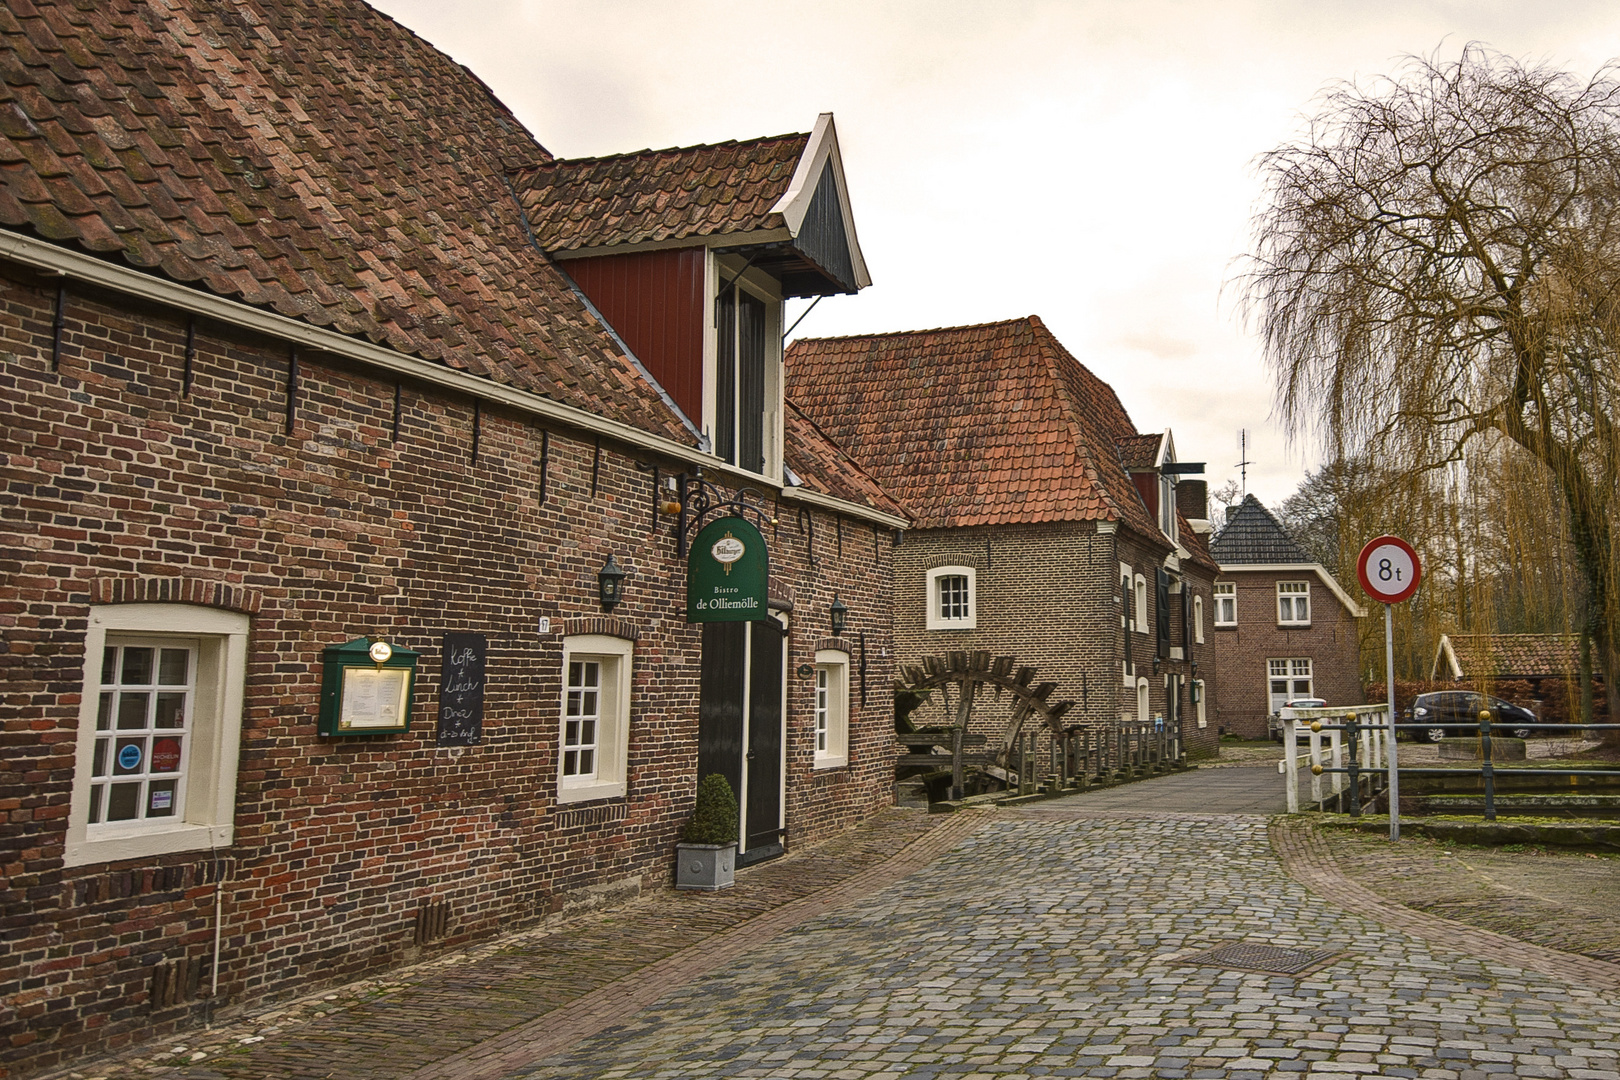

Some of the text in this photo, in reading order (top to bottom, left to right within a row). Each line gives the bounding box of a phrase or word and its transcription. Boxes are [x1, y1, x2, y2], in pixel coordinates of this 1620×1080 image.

[696, 597, 758, 610] de Olliemölle
[450, 644, 477, 666] Koffie
[445, 674, 479, 693] Lunch
